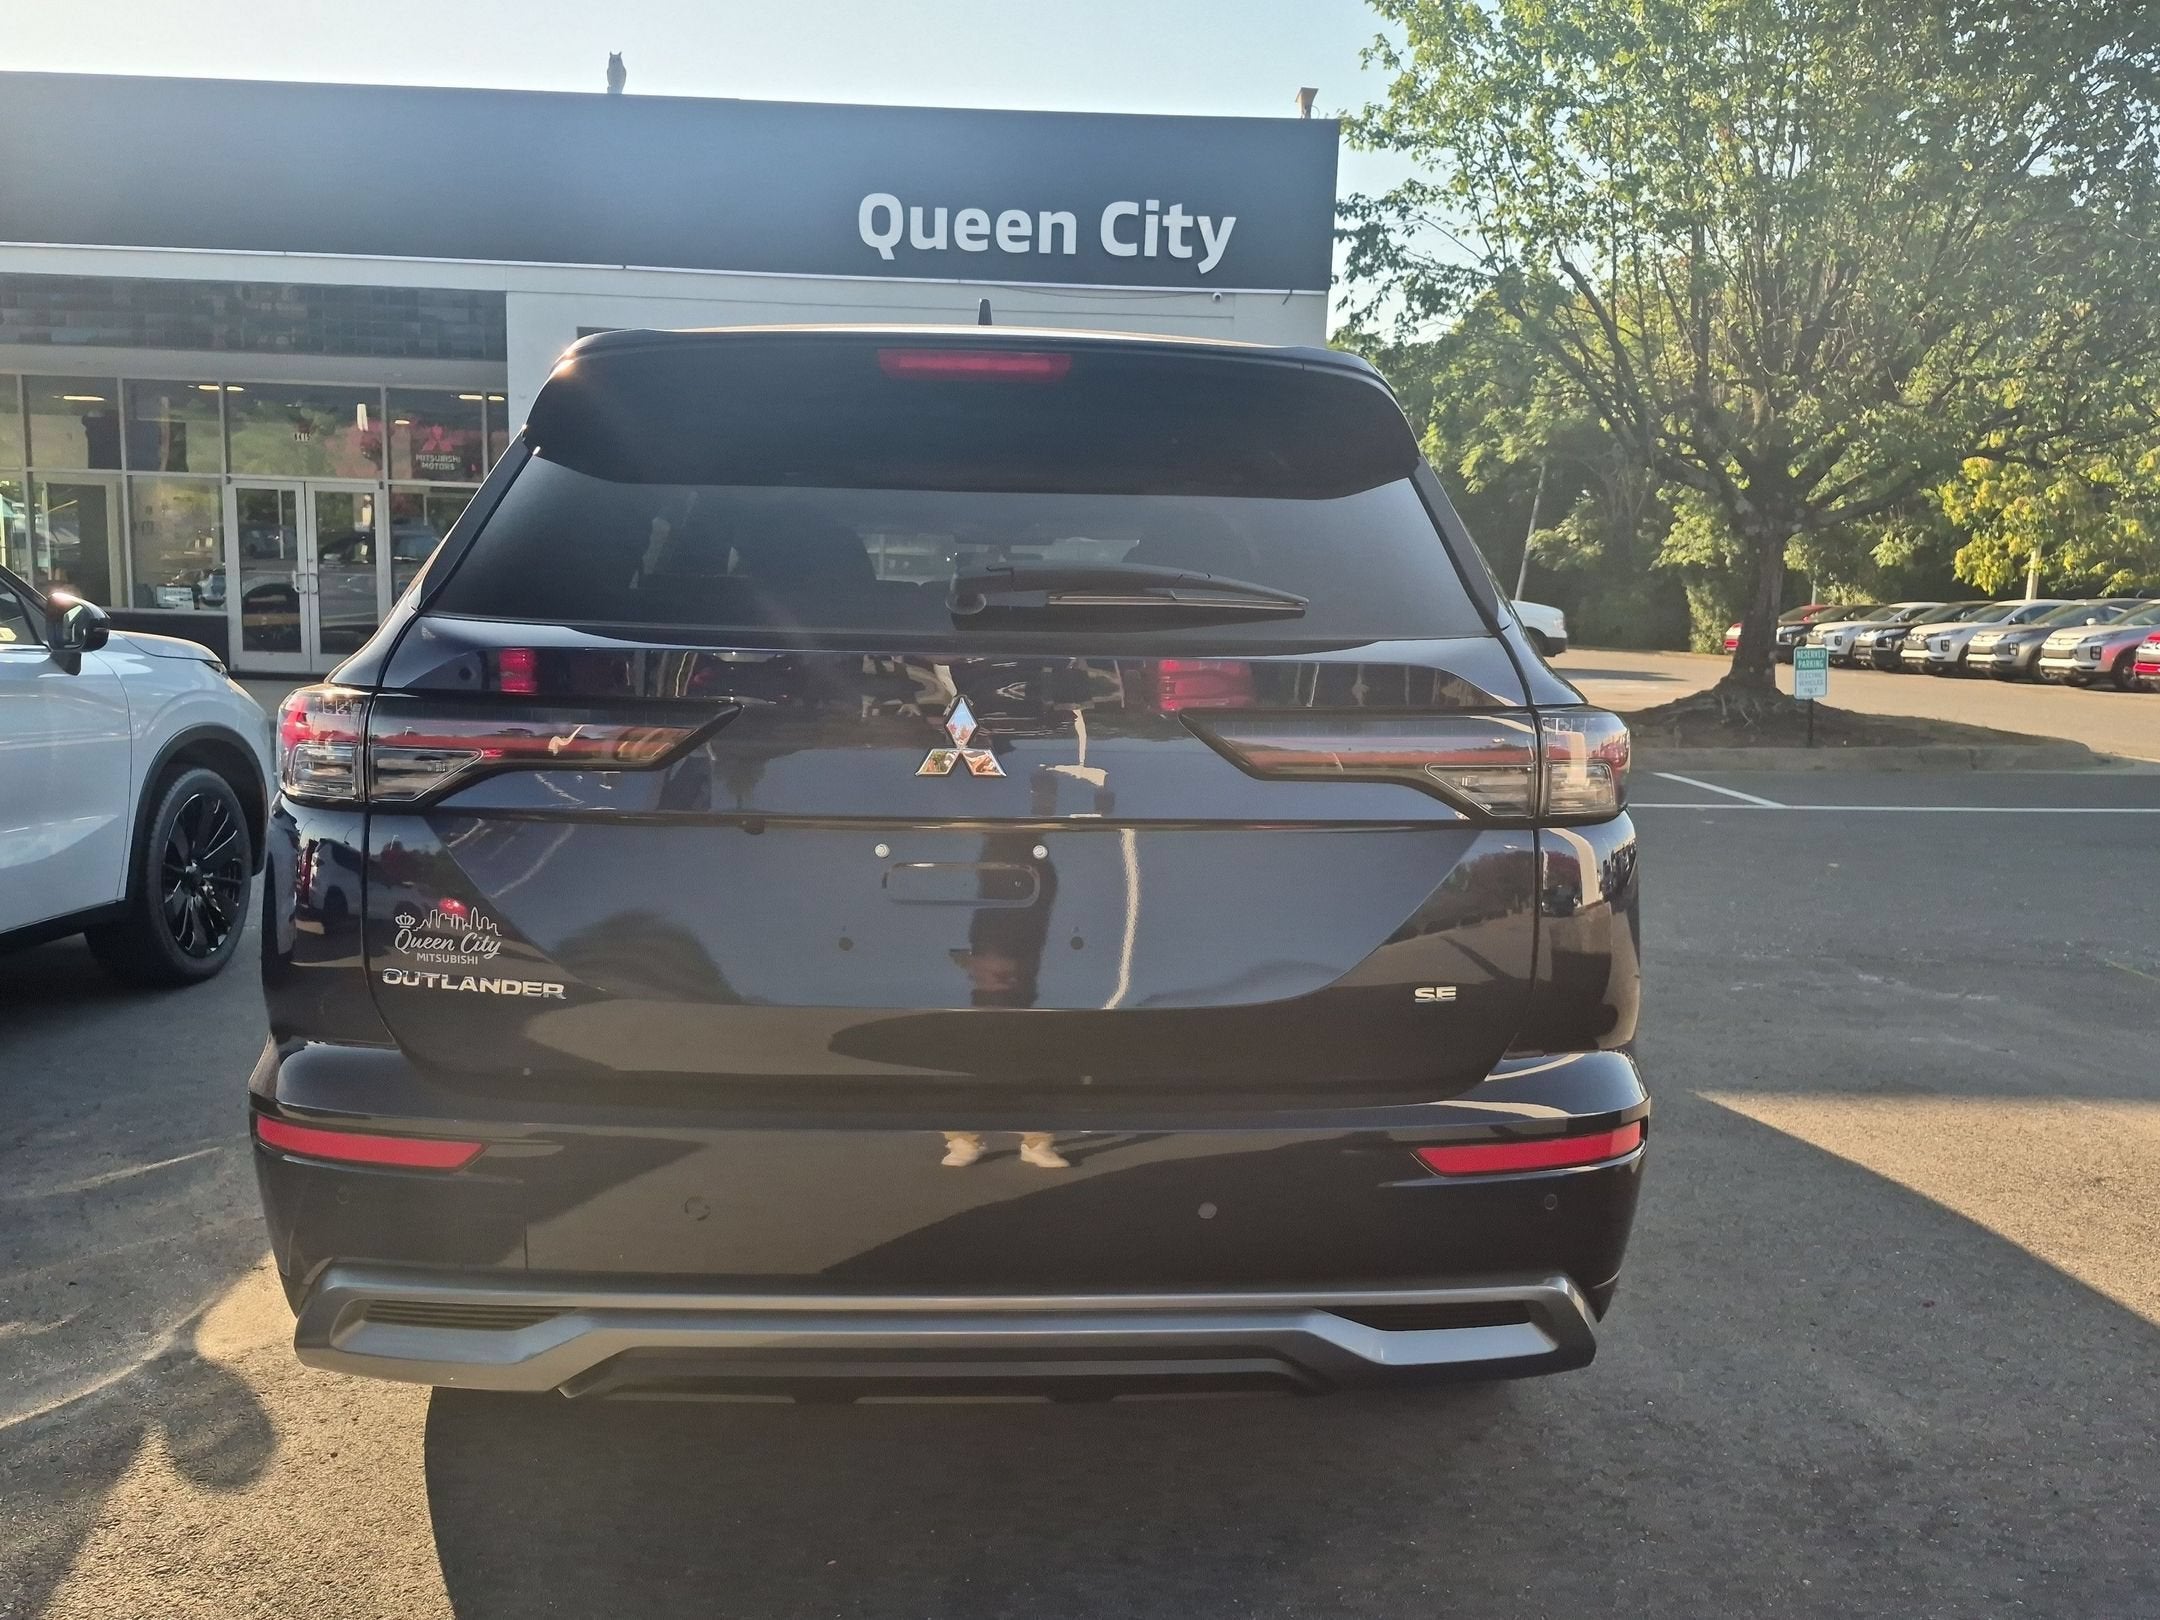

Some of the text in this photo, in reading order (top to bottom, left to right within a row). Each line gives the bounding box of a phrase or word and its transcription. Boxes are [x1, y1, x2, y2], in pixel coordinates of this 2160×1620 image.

[858, 192, 1237, 275] Queen City
[1796, 650, 1825, 659] RESERVED
[1798, 660, 1824, 669] PARKING
[394, 928, 502, 960] Queen City
[416, 952, 479, 966] MITSUBISHI
[382, 967, 567, 1000] OUTLANDER
[1414, 986, 1457, 1003] SE
